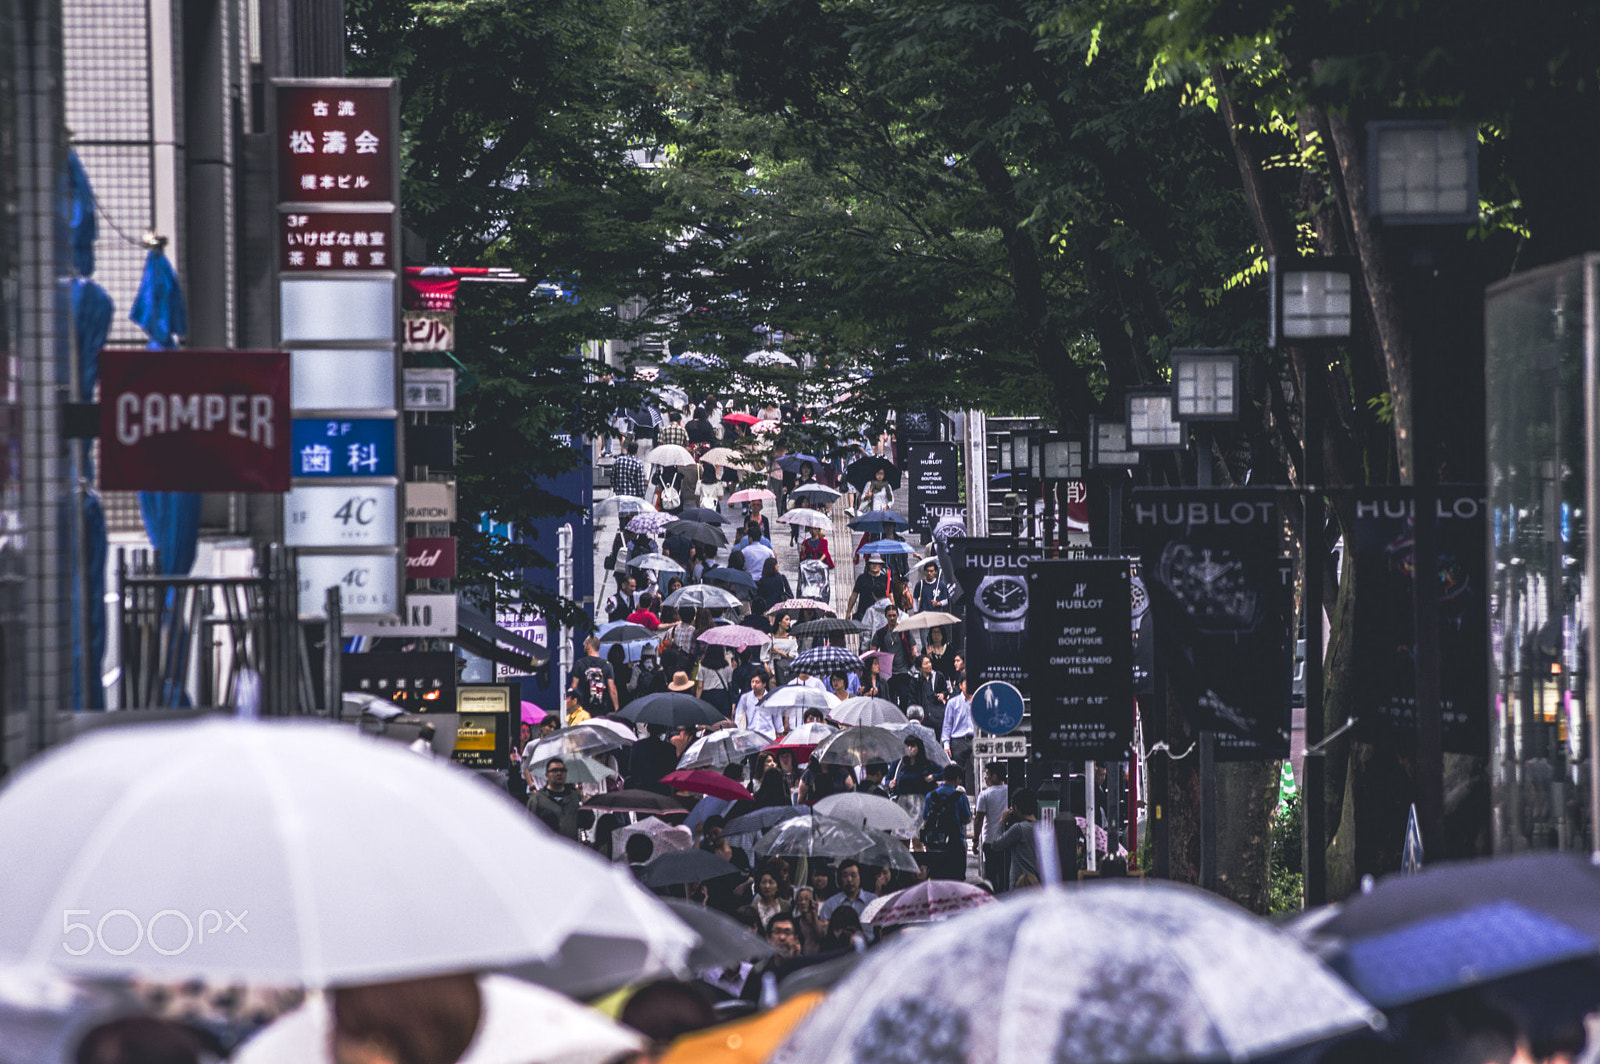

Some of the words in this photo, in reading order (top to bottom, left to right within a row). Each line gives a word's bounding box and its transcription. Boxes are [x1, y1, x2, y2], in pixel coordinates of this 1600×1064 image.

[312, 101, 356, 117] 古流
[289, 130, 379, 154] 松濤会
[287, 215, 309, 227] 3F
[287, 231, 385, 246] いけばな教室
[116, 391, 275, 449] CAMPER
[326, 422, 352, 436] 2F
[301, 443, 379, 473] 歯科
[1136, 502, 1273, 525] HUBLOT
[1056, 599, 1103, 609] HUBLOT
[1063, 627, 1081, 635] POP
[1084, 627, 1096, 635] UP
[1058, 637, 1103, 645] BOUTIQUE
[1049, 656, 1112, 665] OMOTESANDO
[1068, 666, 1094, 675] HILLS
[975, 741, 1024, 755] 歩行者優先
